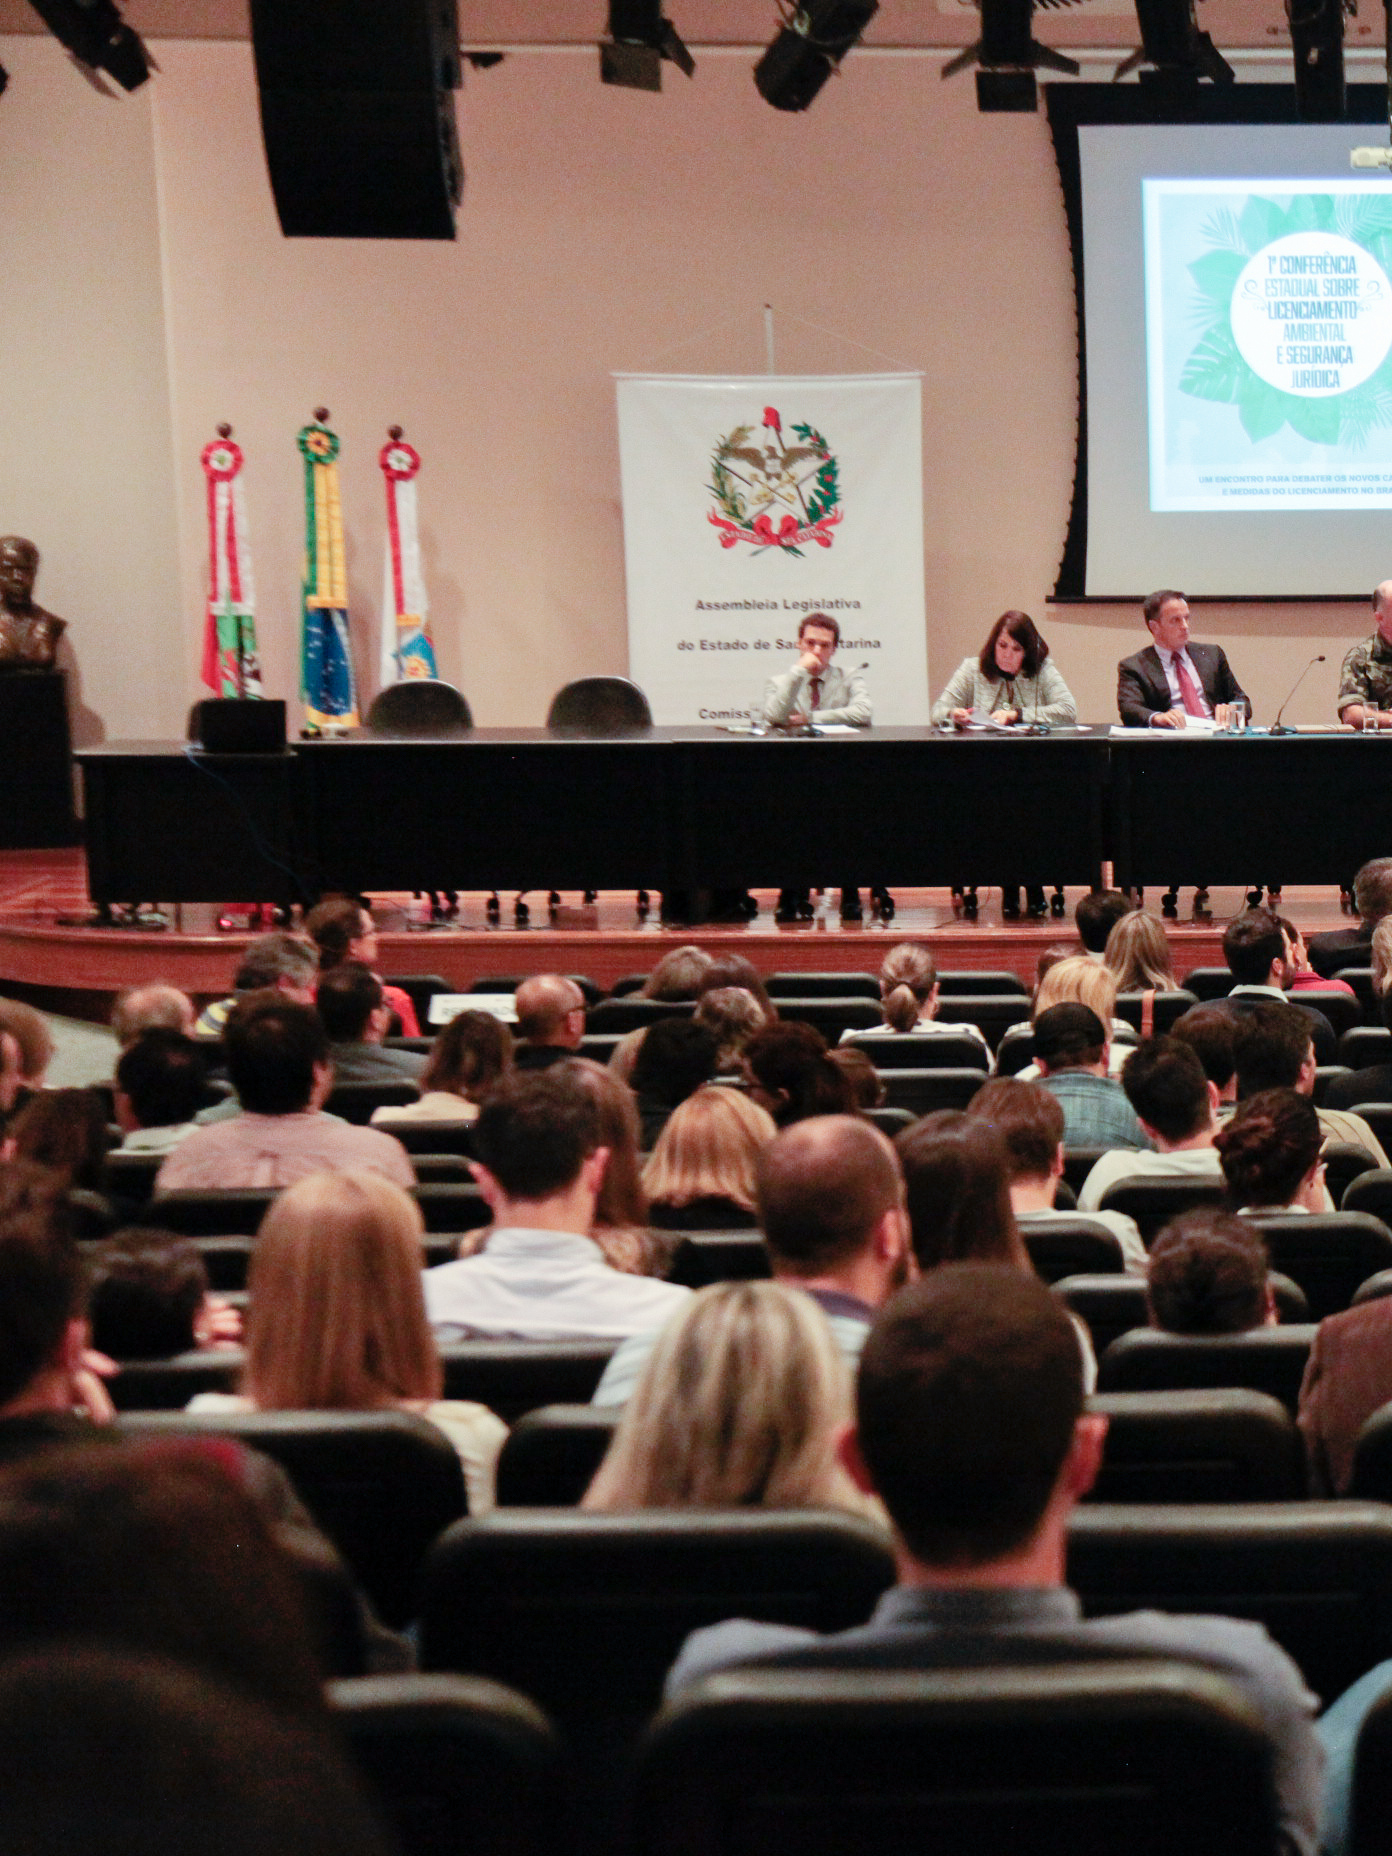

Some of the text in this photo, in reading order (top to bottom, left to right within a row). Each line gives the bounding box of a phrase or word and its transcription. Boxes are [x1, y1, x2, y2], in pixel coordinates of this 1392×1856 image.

[1280, 250, 1358, 275] CONFERÊNCIA
[1265, 278, 1360, 297] ESTADUAL SOBRE
[1267, 300, 1358, 320] LICENCIAMENTO
[1283, 323, 1347, 342] AMBIENTAL
[1276, 345, 1354, 368] E SEGURANÇA
[1290, 366, 1341, 388] JURÍDICA
[1198, 476, 1213, 484] UM
[1215, 475, 1265, 483] ENCONTRO
[1266, 475, 1290, 483] PARA
[1292, 475, 1332, 483] DEBATER
[1348, 474, 1381, 482] NOVOS
[1222, 488, 1228, 496] E
[1230, 488, 1270, 496] MEDIDAS
[1272, 487, 1286, 495] DO
[1287, 487, 1359, 495] LICENCIAMENTO
[1360, 487, 1374, 495] NO
[695, 598, 861, 612] Assembleia Legislativa
[677, 640, 694, 651] do
[699, 639, 749, 651] Estado
[753, 639, 770, 650] de
